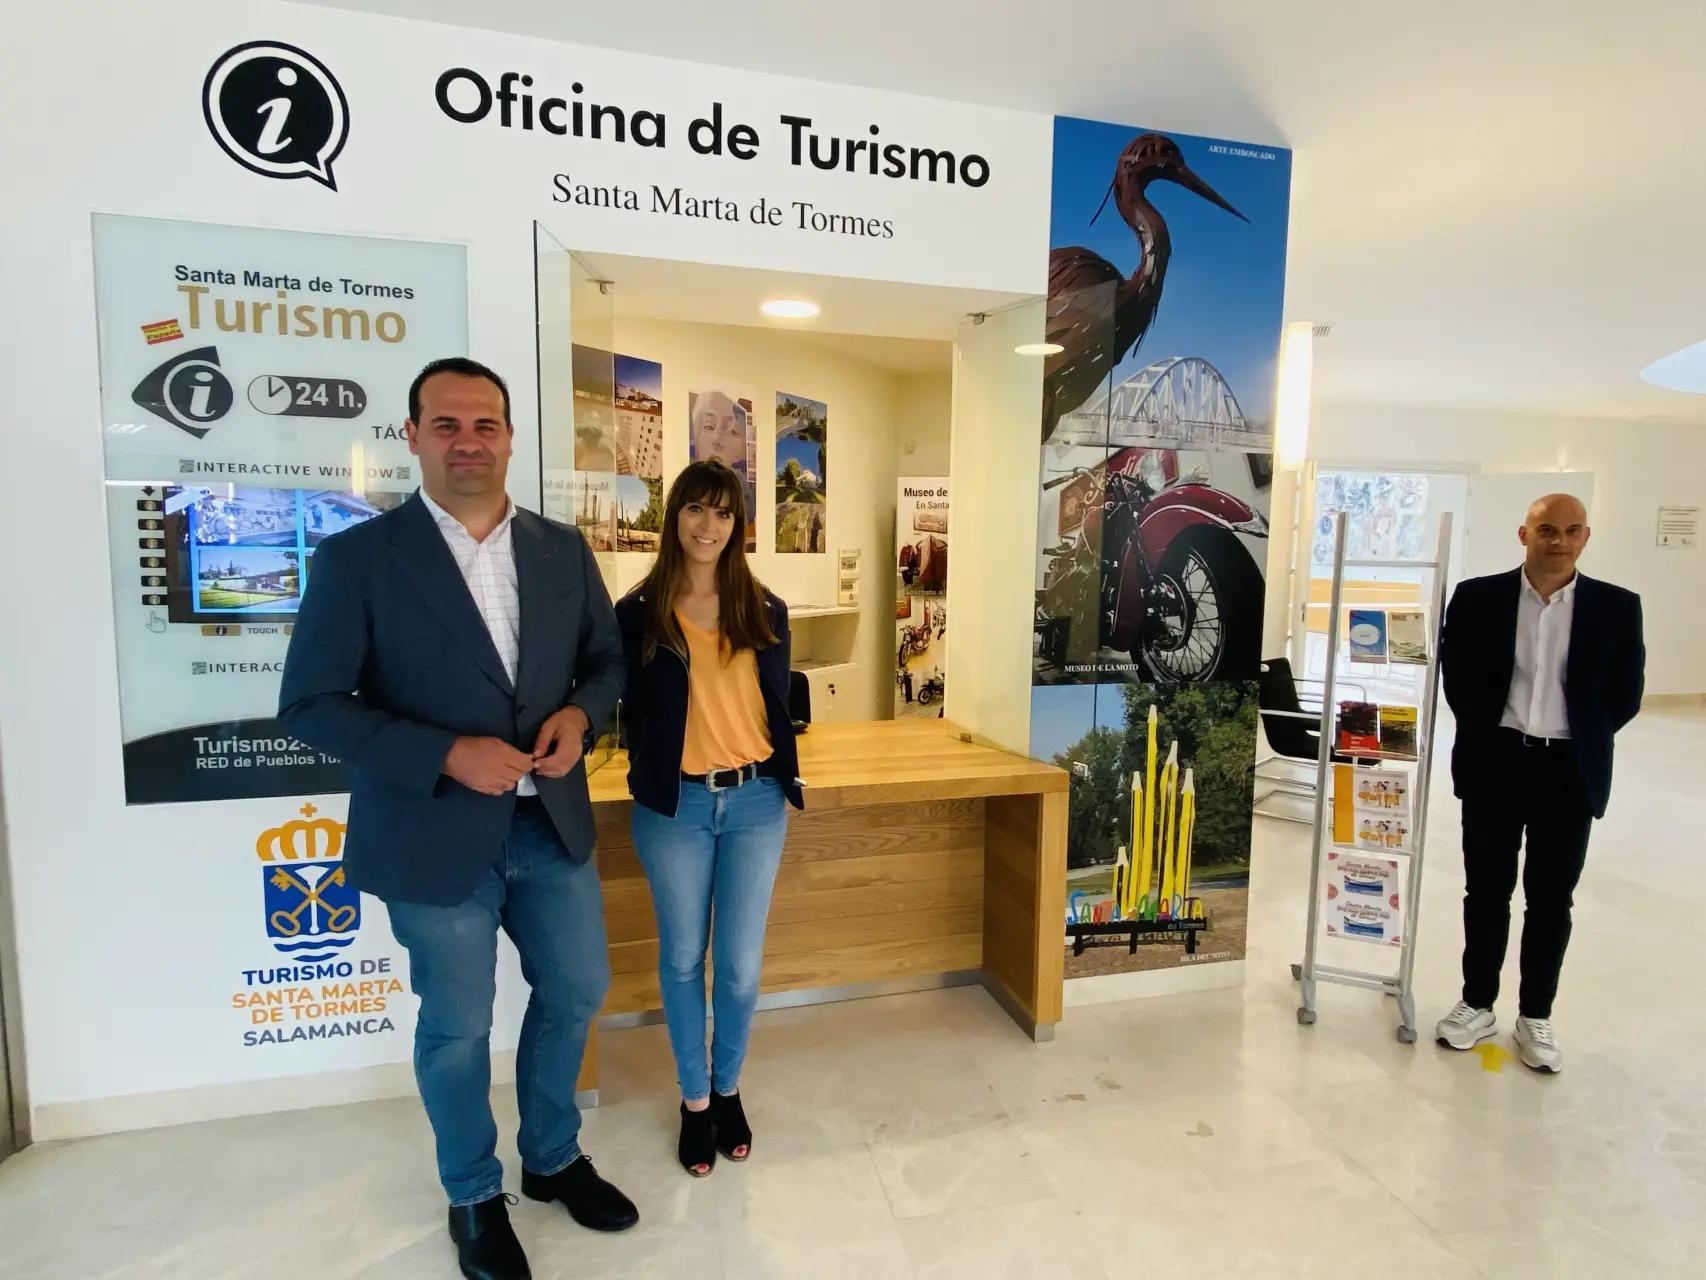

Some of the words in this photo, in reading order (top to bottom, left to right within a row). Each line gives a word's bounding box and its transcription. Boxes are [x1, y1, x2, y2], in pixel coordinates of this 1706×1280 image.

[435, 67, 666, 149] Oficina
[687, 101, 760, 161] de
[779, 114, 991, 188] Turismo
[1208, 145, 1228, 154] ARTE
[552, 173, 640, 211] Santa
[649, 184, 740, 222] Marta
[749, 197, 784, 227] de
[792, 201, 894, 239] Tormes
[174, 265, 236, 285] Santa
[242, 270, 302, 291] Marta
[308, 277, 333, 293] de
[339, 278, 415, 300] Tormes
[177, 284, 407, 343] Turismo
[295, 382, 329, 407] 24
[337, 383, 364, 409] h.
[197, 461, 311, 477] INTERACTIVE
[318, 465, 393, 479] WINOW
[904, 487, 935, 497] Museo
[936, 486, 948, 497] de
[916, 500, 926, 510] En
[927, 501, 950, 510] Santa
[247, 627, 279, 635] TOUCH
[1064, 664, 1092, 673] MUSEO
[1115, 663, 1139, 673] MOTO
[193, 736, 313, 755] Turismo2
[196, 757, 229, 769] RED
[233, 756, 252, 768] de
[256, 753, 316, 767] Pueblos
[242, 962, 353, 985] TURISMO
[360, 958, 392, 975] DE
[232, 987, 315, 1009] SANTA
[322, 978, 404, 1001] MARTA
[251, 1007, 284, 1025] DE
[290, 997, 387, 1020] TORMES
[243, 1017, 395, 1046] SALAMANCA
